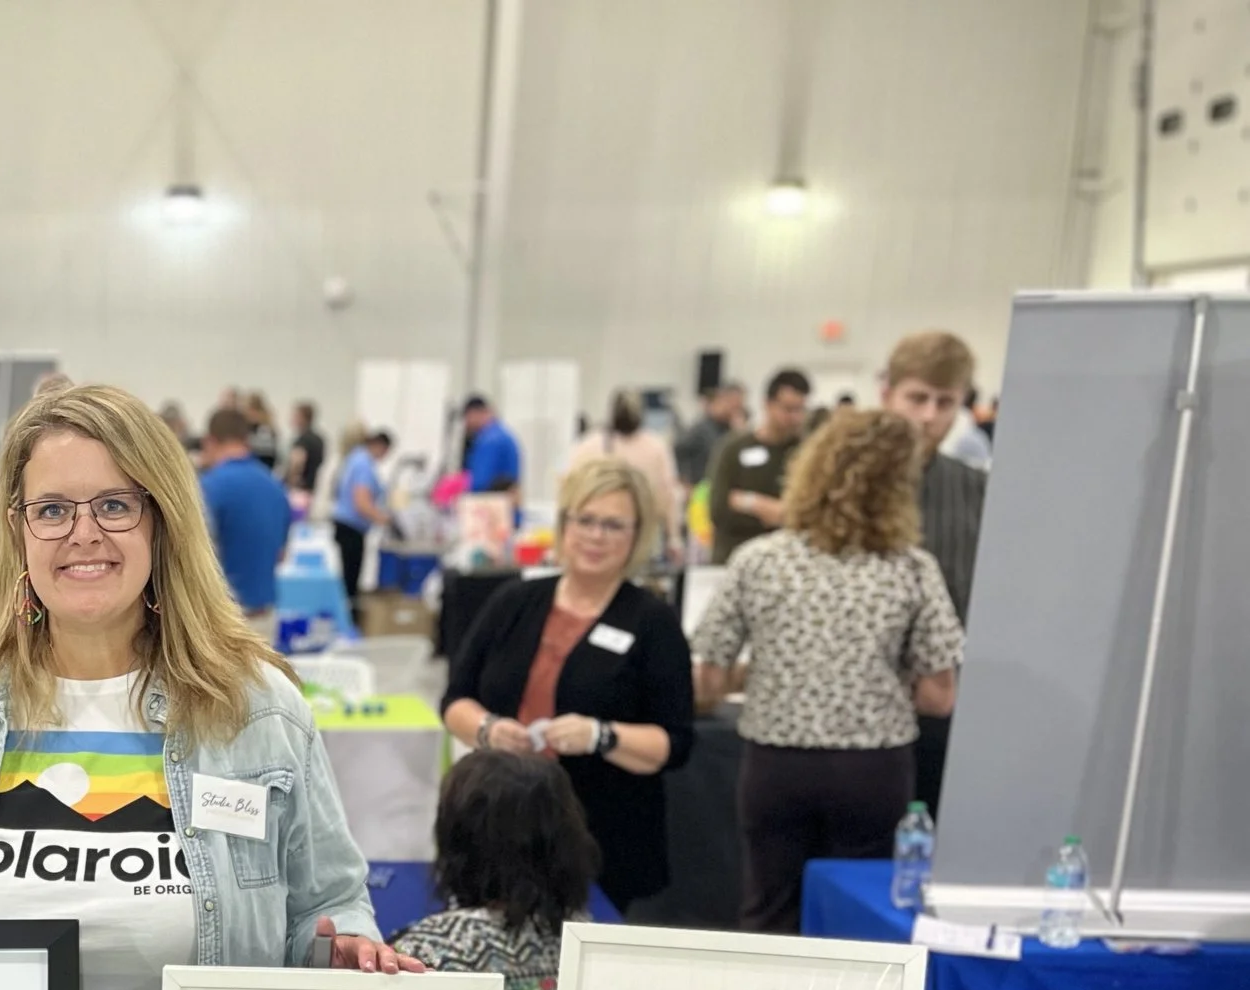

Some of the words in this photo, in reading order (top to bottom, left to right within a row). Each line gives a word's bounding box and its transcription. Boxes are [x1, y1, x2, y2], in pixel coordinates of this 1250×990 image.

[235, 798, 260, 816] Bliss
[134, 886, 151, 896] BE
[155, 884, 194, 895] ORIG
